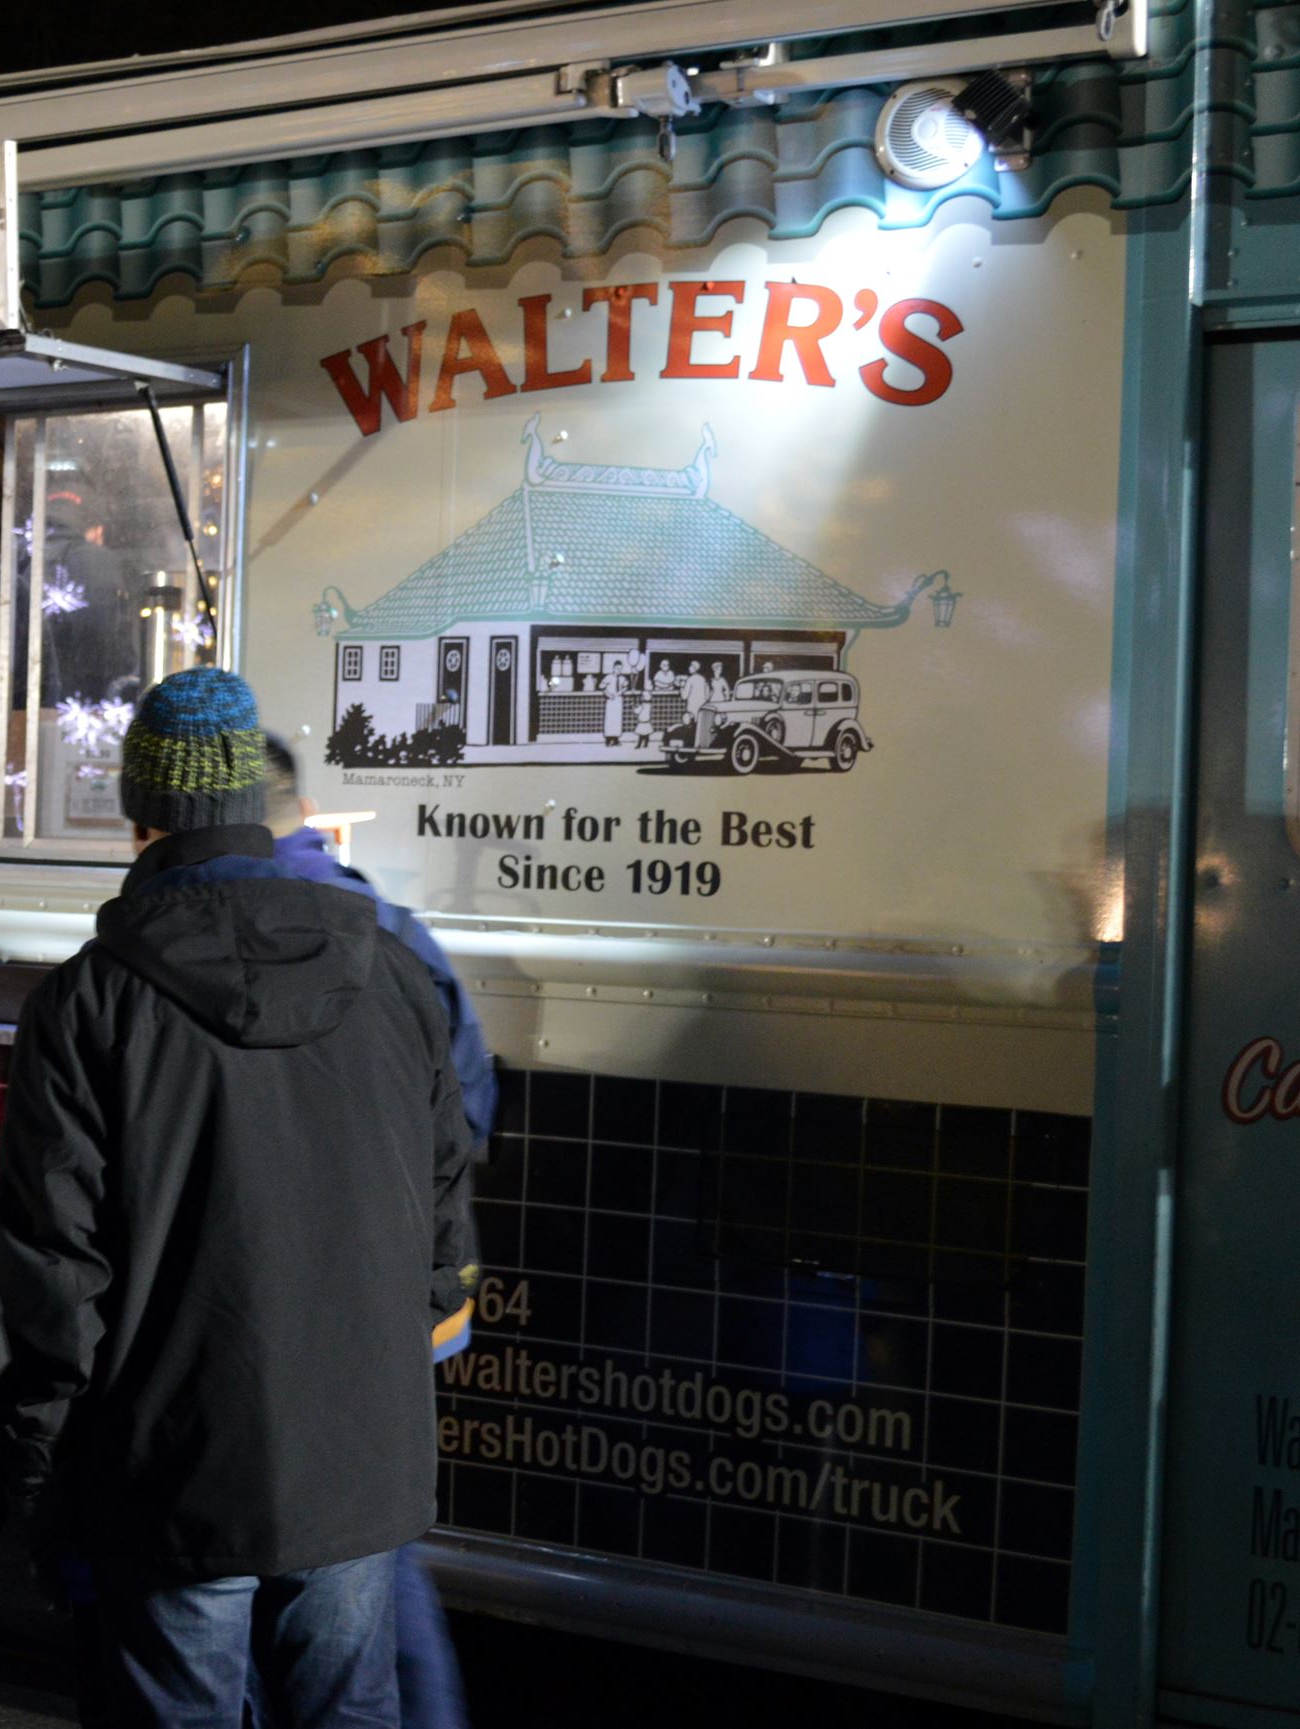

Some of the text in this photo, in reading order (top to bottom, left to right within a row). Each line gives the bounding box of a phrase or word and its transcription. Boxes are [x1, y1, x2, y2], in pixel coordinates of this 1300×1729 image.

[319, 280, 964, 437] WALTER'S
[342, 772, 466, 790] Mamaroneck, NY
[416, 803, 816, 849] Known for the Best
[498, 854, 722, 896] Since 1919
[478, 1276, 532, 1326] 64
[442, 1345, 912, 1450] waltershotdogs.com
[438, 1413, 962, 1535] ersHotDogs.com/truck
[1245, 1577, 1300, 1654] 02-
